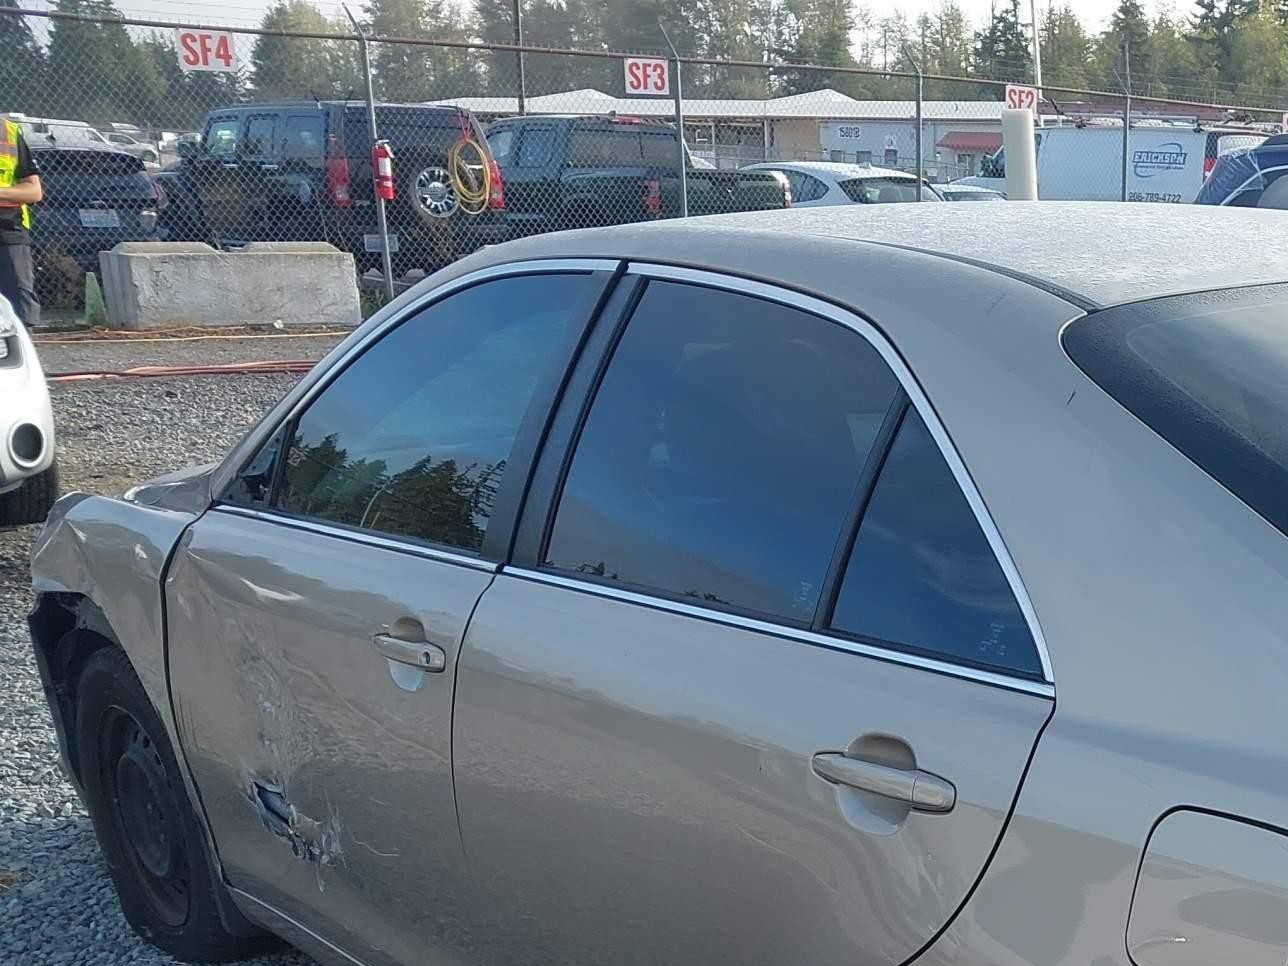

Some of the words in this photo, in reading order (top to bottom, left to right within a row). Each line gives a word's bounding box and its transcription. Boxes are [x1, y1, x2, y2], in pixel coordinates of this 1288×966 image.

[180, 32, 233, 67] SF4
[628, 61, 666, 91] SF3
[1007, 88, 1035, 109] SF2
[1133, 152, 1186, 164] ERICKSON
